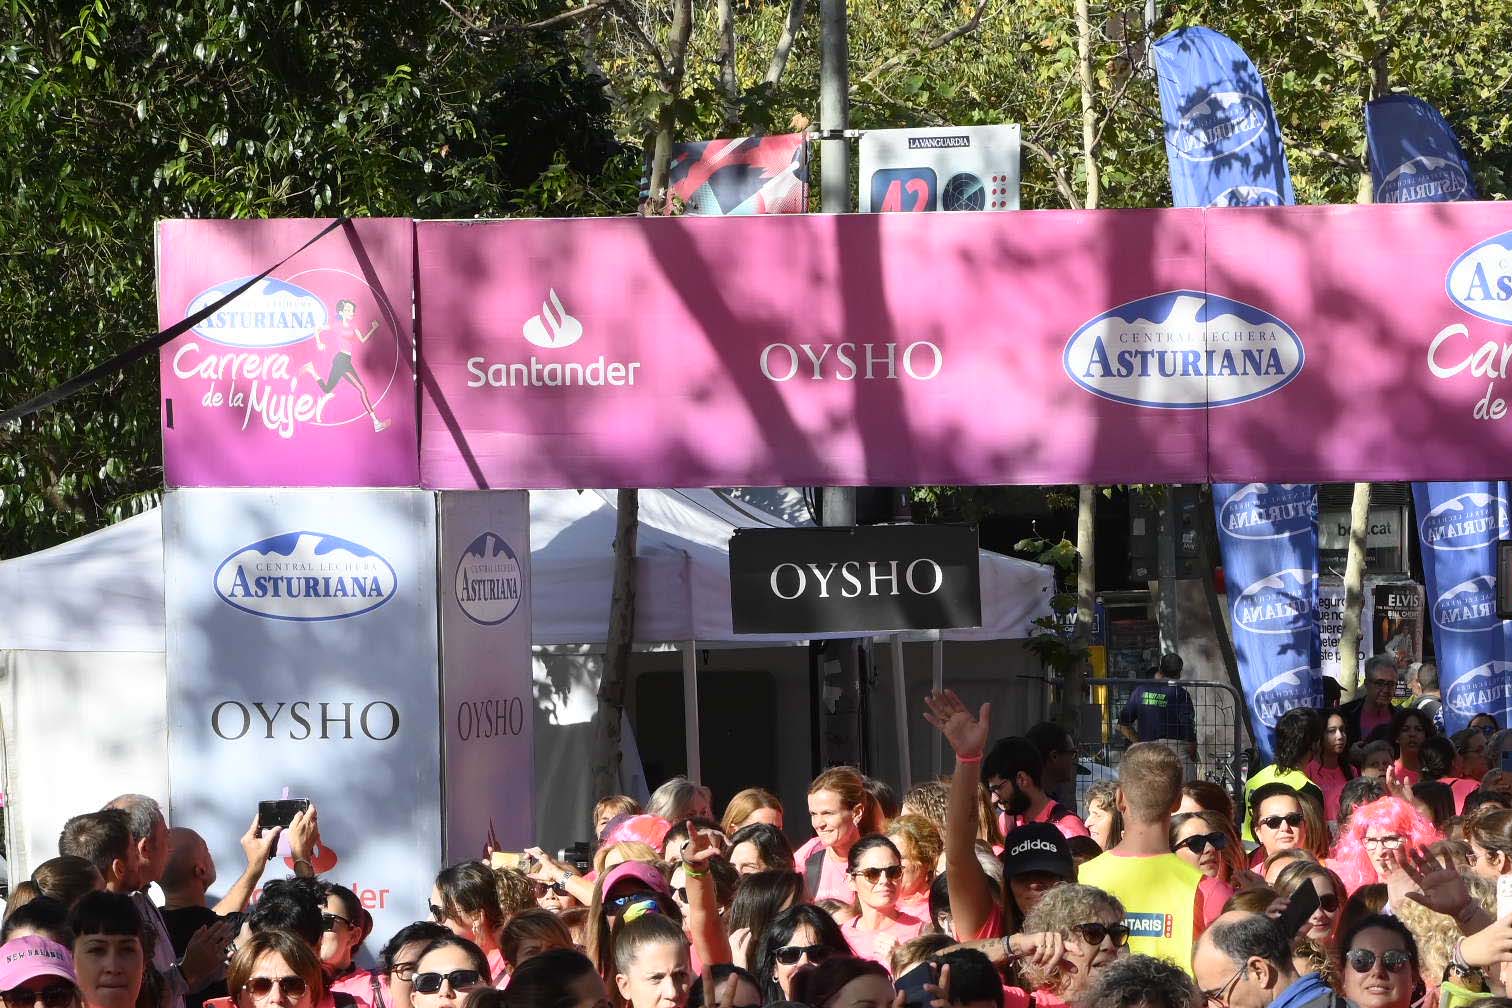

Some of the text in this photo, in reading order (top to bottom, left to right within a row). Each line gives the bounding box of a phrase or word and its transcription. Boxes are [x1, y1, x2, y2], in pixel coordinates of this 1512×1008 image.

[1120, 330, 1277, 343] CENTRAL LECHERA
[173, 342, 290, 381] Carrera
[466, 356, 641, 388] Santander
[759, 340, 943, 382] OYSHO
[1082, 335, 1285, 378] ASTURIANA
[201, 378, 337, 439] de la Mujer
[1473, 382, 1508, 421] de
[227, 564, 385, 599] ASTURIANA
[460, 567, 518, 604] ASTURIANA
[769, 557, 944, 600] OYSHO
[1388, 594, 1419, 607] ELVIS
[211, 700, 400, 741] OYSHO
[457, 696, 524, 742] OYSHO
[1011, 838, 1058, 856] adidas
[6, 952, 25, 964] NEW
